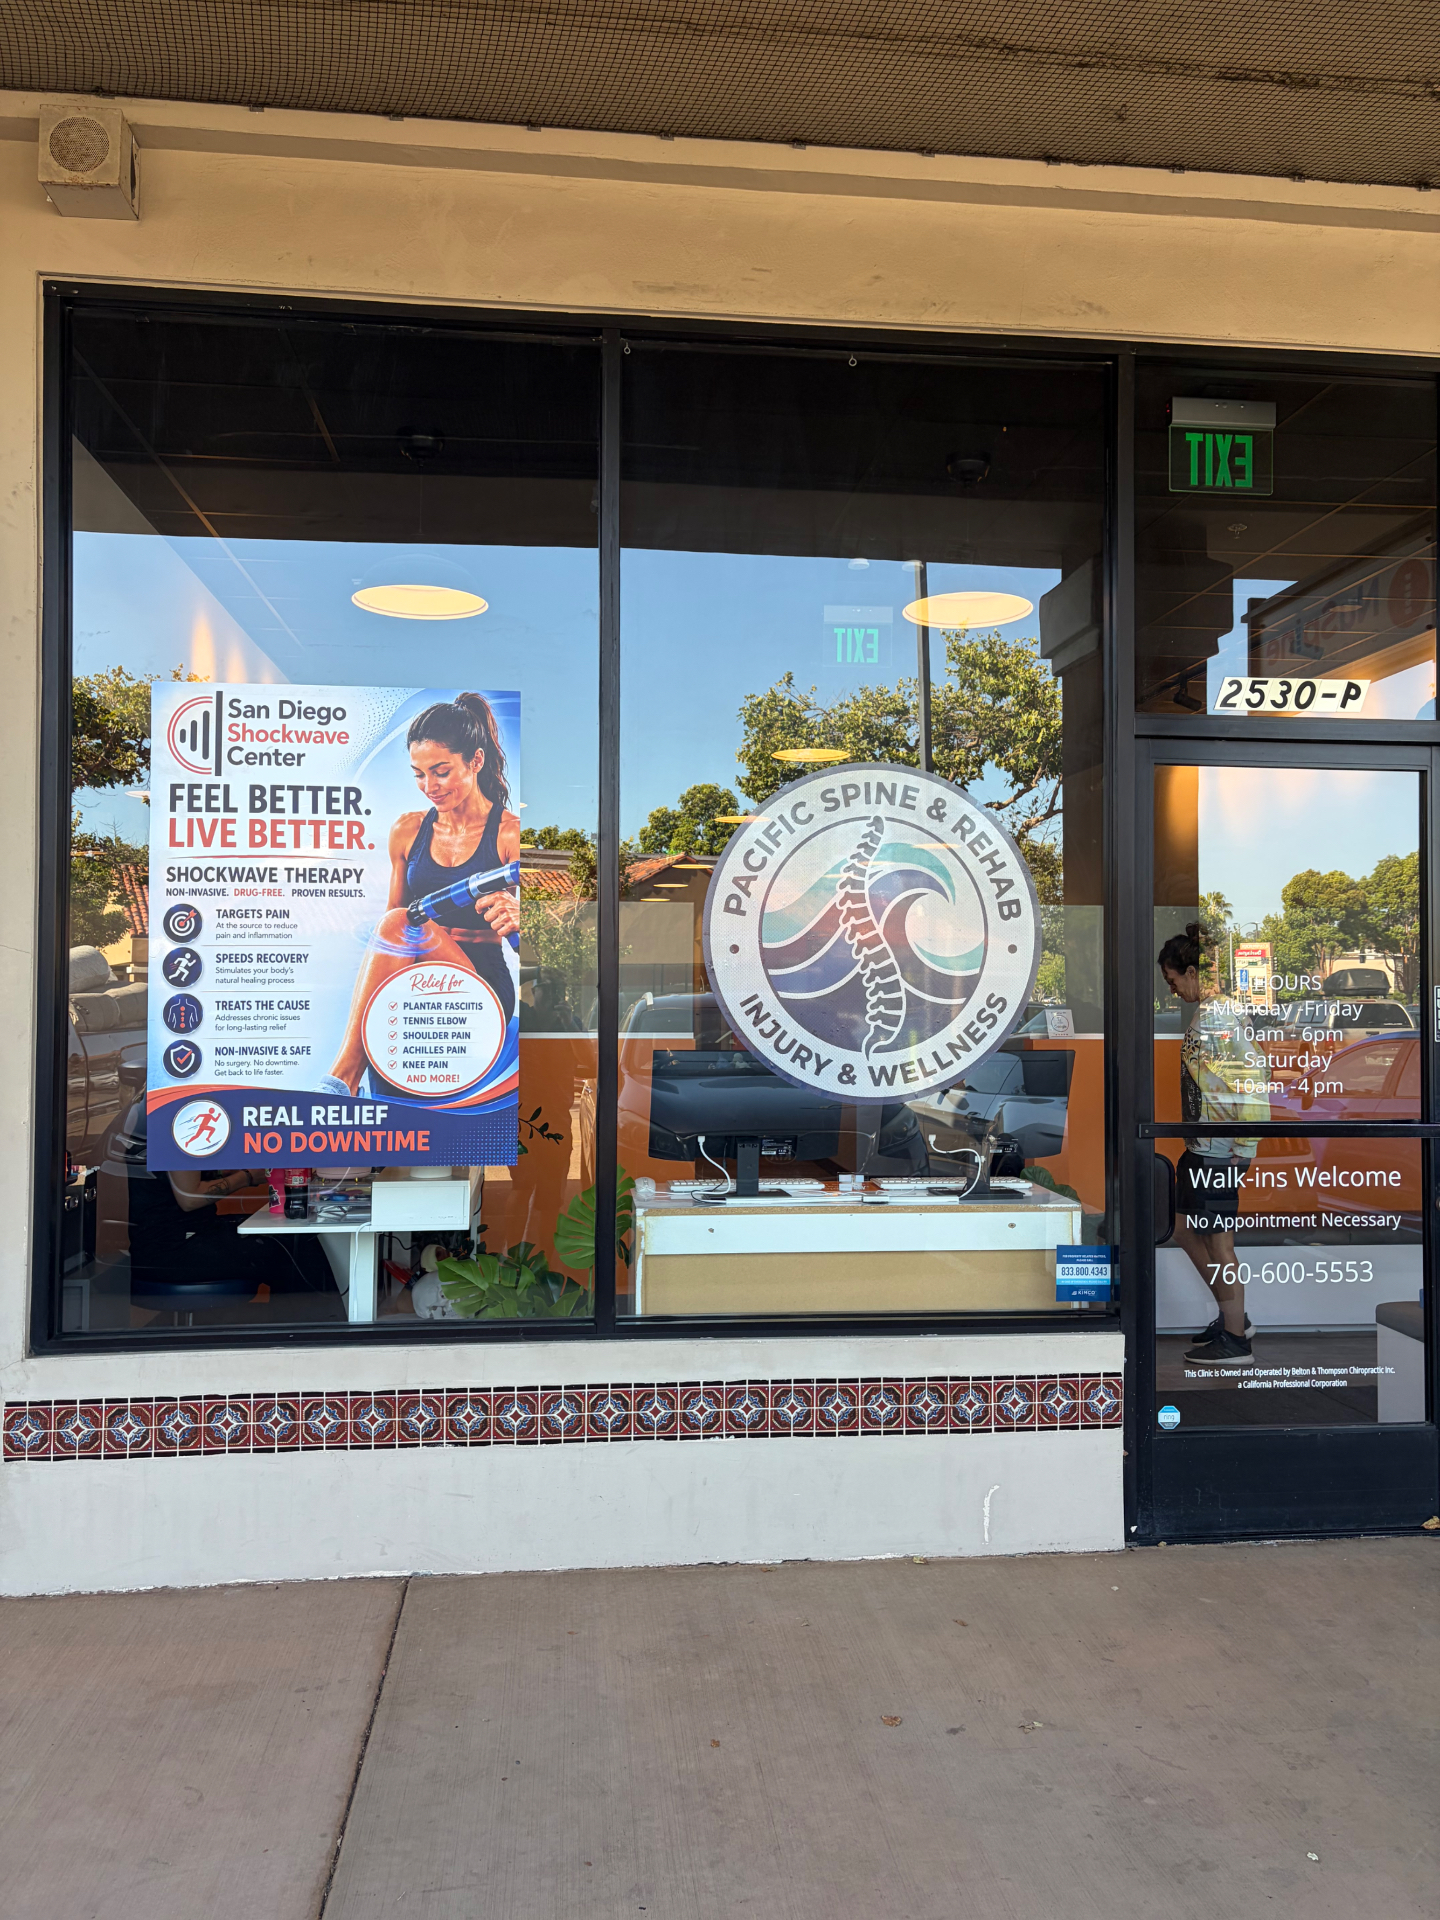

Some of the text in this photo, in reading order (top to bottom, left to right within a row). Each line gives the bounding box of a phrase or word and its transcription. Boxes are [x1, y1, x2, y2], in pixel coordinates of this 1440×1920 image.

[1219, 679, 1361, 710] 2530-P
[228, 699, 346, 725] San Diego
[227, 723, 349, 744] Shockwave
[227, 747, 305, 766] Center
[170, 784, 372, 816] FEEL BETTER.
[169, 818, 375, 850] LIVE BETTER.
[723, 781, 1022, 922] PACIFIC SPINE & REHAB
[166, 867, 364, 883] SHOCKWAVE THERAPY
[166, 888, 365, 898] NON-INVASIVE. DRUG-FREE. PROVEN RESULTS.
[216, 909, 289, 919] TARGETS PAIN
[216, 932, 230, 940] pain
[216, 954, 309, 963] SPEEDS RECOVERY
[253, 968, 268, 976] your
[271, 967, 293, 976] body's
[241, 977, 266, 985] healing
[410, 973, 464, 991] Relief for
[1254, 975, 1321, 991] HOURS
[215, 1000, 310, 1010] TREATS THE CAUSE
[403, 1002, 442, 1010] PLANTAR
[1213, 1001, 1292, 1021] Monday
[227, 1024, 267, 1032] long-lasting
[403, 1017, 467, 1025] TENNIS ELBOW
[403, 1032, 448, 1040] SHOULDER
[740, 992, 1007, 1087] INJURY & WELLNESS
[1234, 1027, 1283, 1042] 10am
[1303, 1027, 1343, 1045] 6pm
[215, 1046, 311, 1056] NON-INVASIVE & SAFE
[403, 1046, 466, 1054] ACHILLES PAIN
[1244, 1052, 1332, 1072] Saturday
[1234, 1079, 1283, 1094] 10am
[243, 1105, 388, 1127] REAL RELIEF
[244, 1131, 430, 1153] NO DOWNTIME
[1189, 1166, 1401, 1189] Walk-ins Welcome
[1186, 1213, 1401, 1232] No Appointment Necessary
[1062, 1267, 1107, 1276] 833.800.4343
[1207, 1261, 1374, 1285] 760-600-5553
[1184, 1369, 1196, 1378] This
[1197, 1369, 1213, 1378] Clinic
[1220, 1368, 1241, 1377] Owned
[1242, 1368, 1254, 1377] and
[1254, 1367, 1282, 1378] Operated
[1283, 1367, 1291, 1378] by
[1291, 1367, 1310, 1376] Belton
[1311, 1367, 1316, 1375] &
[1317, 1366, 1348, 1377] Thompson
[1349, 1366, 1384, 1376] Chiropractic
[1385, 1366, 1396, 1374] Inc.
[1243, 1380, 1272, 1389] California
[1273, 1379, 1310, 1389] Professional
[1311, 1379, 1347, 1389] Corporation
